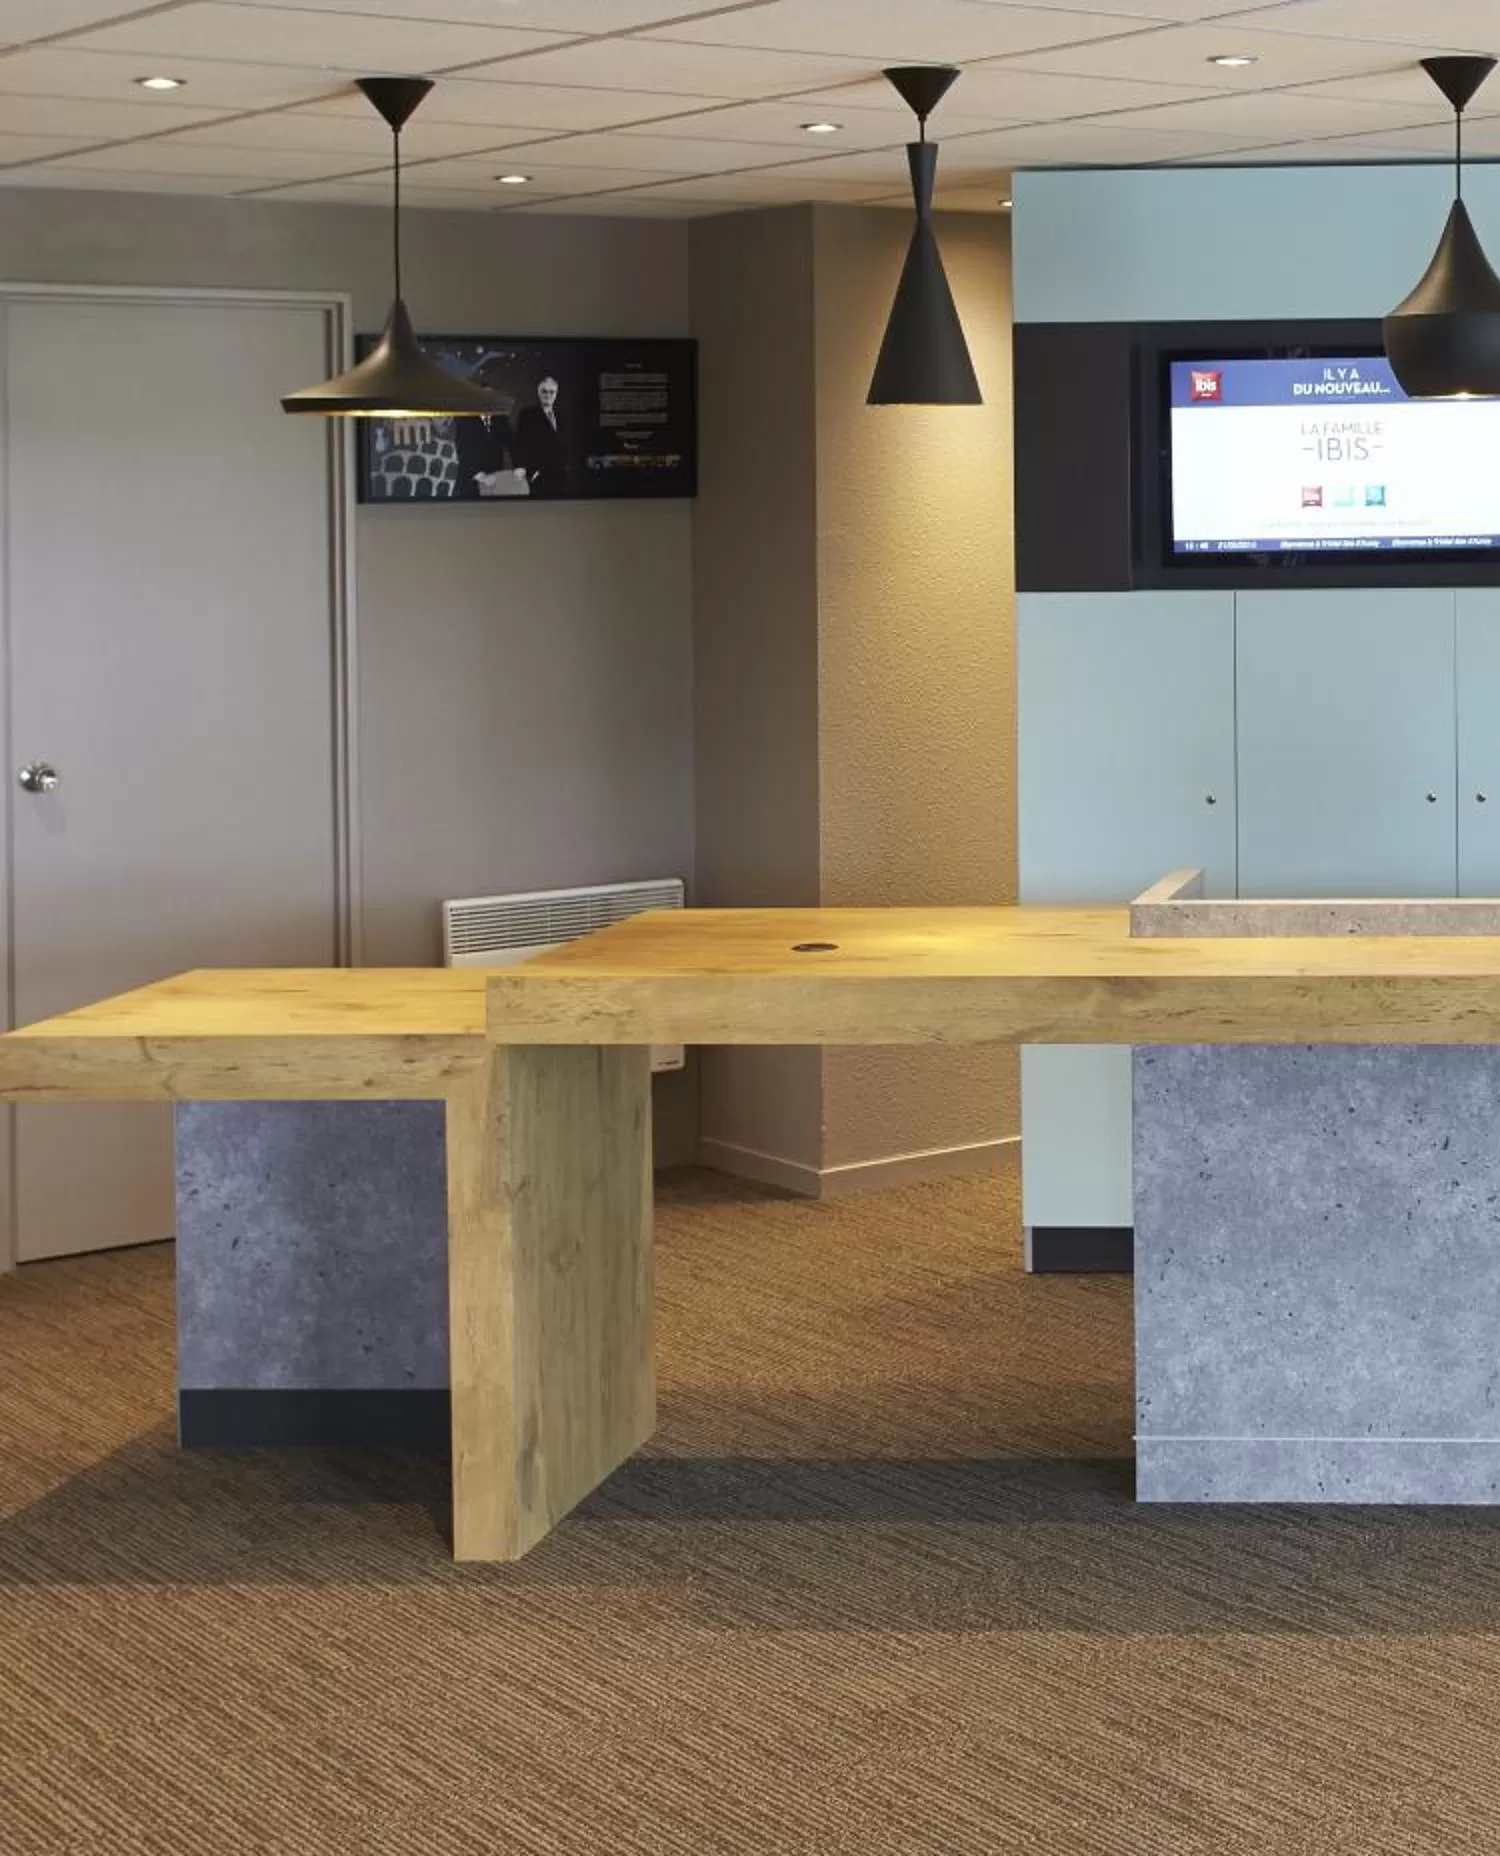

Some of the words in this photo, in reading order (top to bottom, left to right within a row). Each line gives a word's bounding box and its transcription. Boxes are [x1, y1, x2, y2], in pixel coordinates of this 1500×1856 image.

[1323, 367, 1337, 381] IL
[1337, 367, 1348, 380] Y
[1349, 367, 1360, 380] A
[1195, 377, 1217, 392] ibis
[1293, 383, 1313, 396] DU
[1300, 421, 1320, 436] LA
[1322, 421, 1385, 437] FAMILLE
